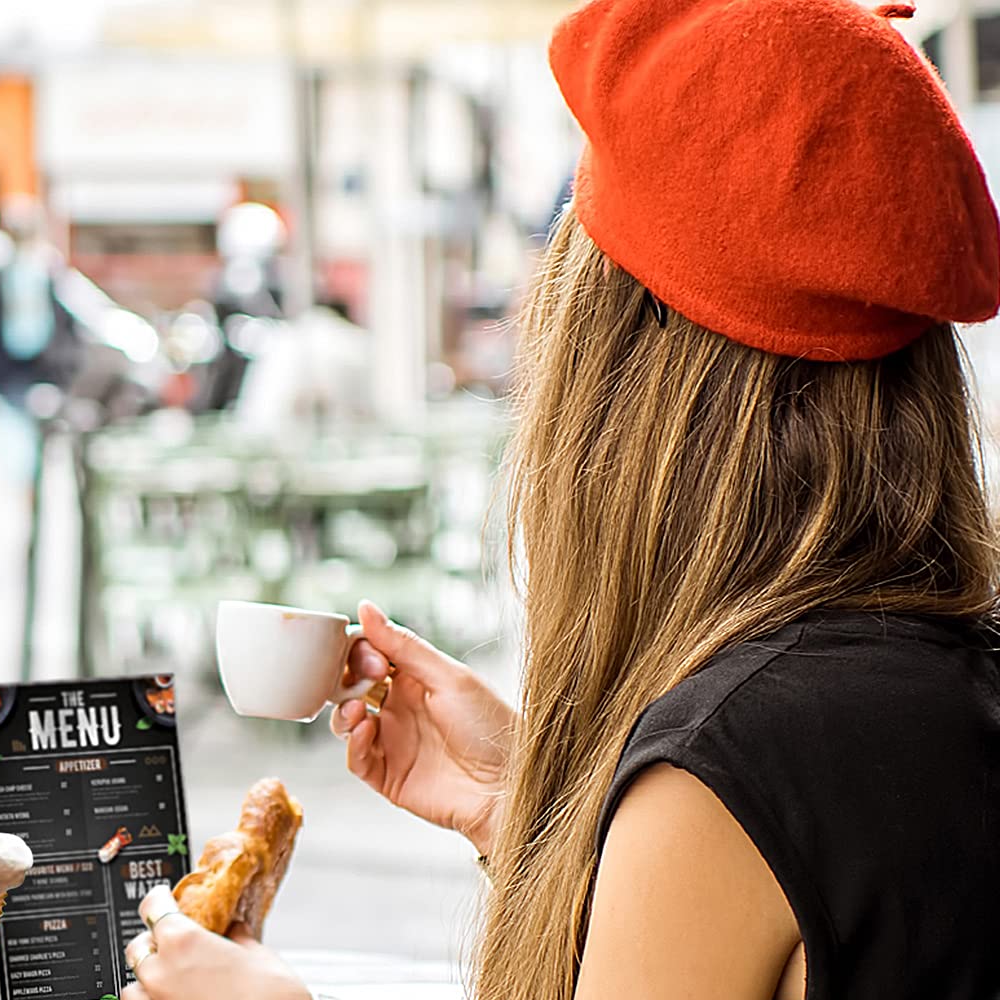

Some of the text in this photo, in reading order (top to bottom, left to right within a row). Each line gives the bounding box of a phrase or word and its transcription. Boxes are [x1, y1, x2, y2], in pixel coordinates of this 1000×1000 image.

[61, 690, 85, 707] THE
[28, 705, 122, 750] MENU
[129, 860, 163, 879] BEST
[43, 919, 67, 931] PIZZA
